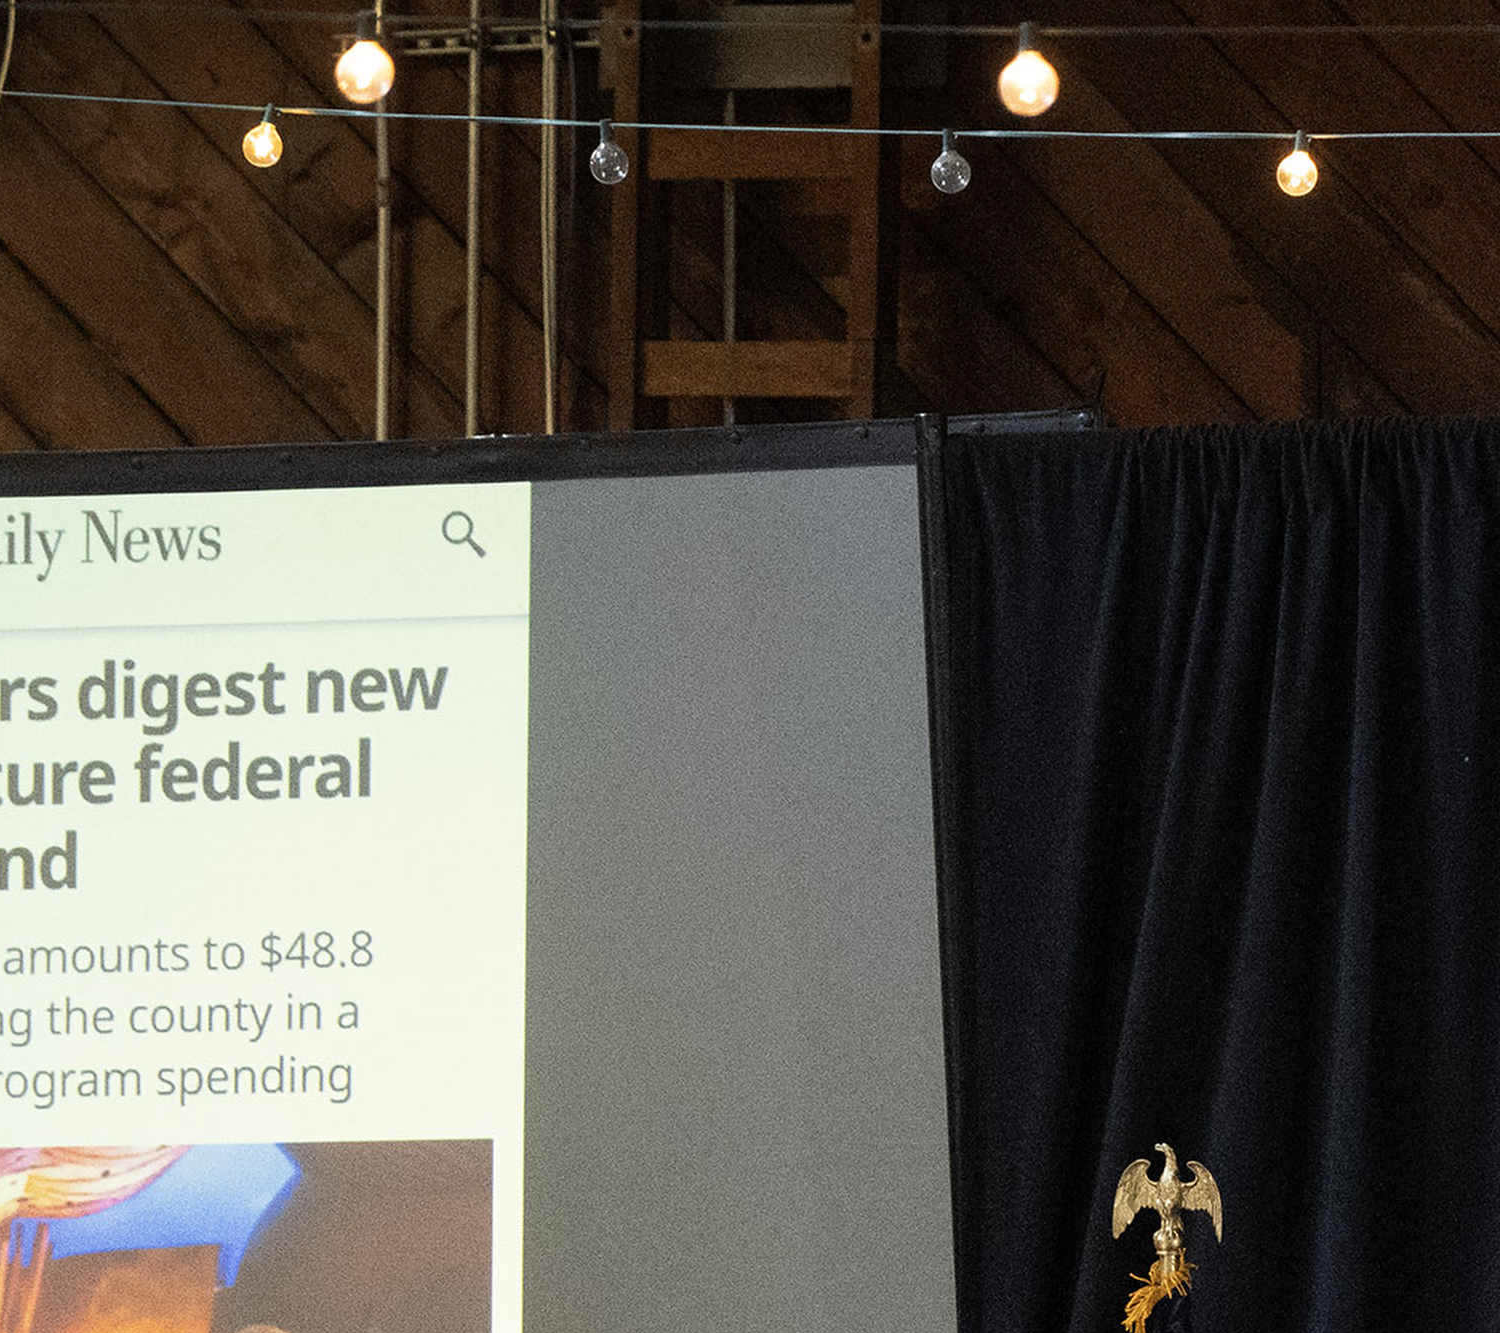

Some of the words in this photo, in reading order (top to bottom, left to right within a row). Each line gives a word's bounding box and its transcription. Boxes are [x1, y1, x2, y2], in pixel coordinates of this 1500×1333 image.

[82, 509, 222, 563] News
[78, 659, 286, 736] digest
[306, 666, 449, 714] new
[134, 737, 371, 803] federal
[3, 939, 190, 975] amounts
[204, 938, 245, 971] to
[261, 930, 373, 972] $48.8
[47, 997, 114, 1035] the
[129, 998, 272, 1043] county
[287, 1002, 322, 1030] in
[337, 1001, 359, 1029] a
[157, 1055, 352, 1107] spending
